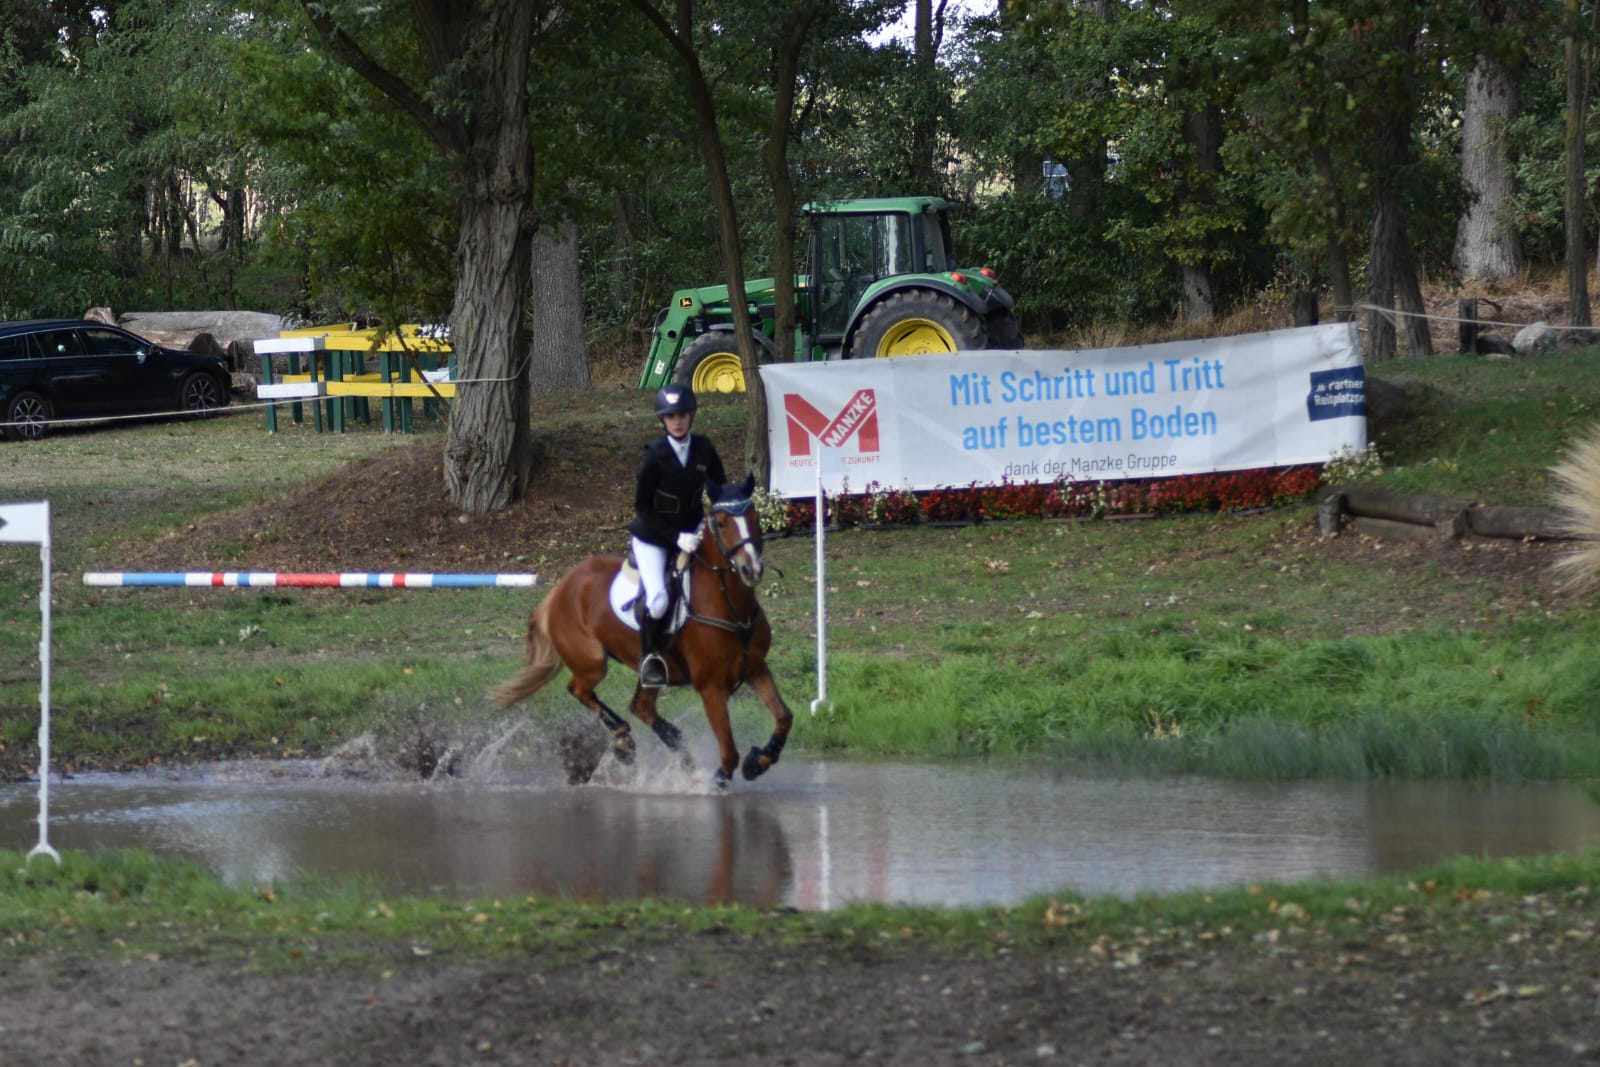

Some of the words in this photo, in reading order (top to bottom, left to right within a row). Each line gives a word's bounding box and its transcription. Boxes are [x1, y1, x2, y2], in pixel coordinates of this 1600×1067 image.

[950, 373, 992, 406] Mit
[1000, 367, 1096, 403] Schritt
[1104, 361, 1156, 396] und
[1163, 357, 1225, 392] Tritt
[825, 391, 873, 447] MANZKE
[962, 416, 1007, 450] auf
[1016, 414, 1122, 447] bestem
[1130, 405, 1218, 440] Boden
[789, 459, 813, 467] HEUTE
[847, 455, 881, 464] ZUKUNFT
[1004, 460, 1039, 477] dank
[1043, 457, 1067, 474] der
[1071, 454, 1124, 473] Manzke
[1127, 453, 1177, 470] Gruppe
